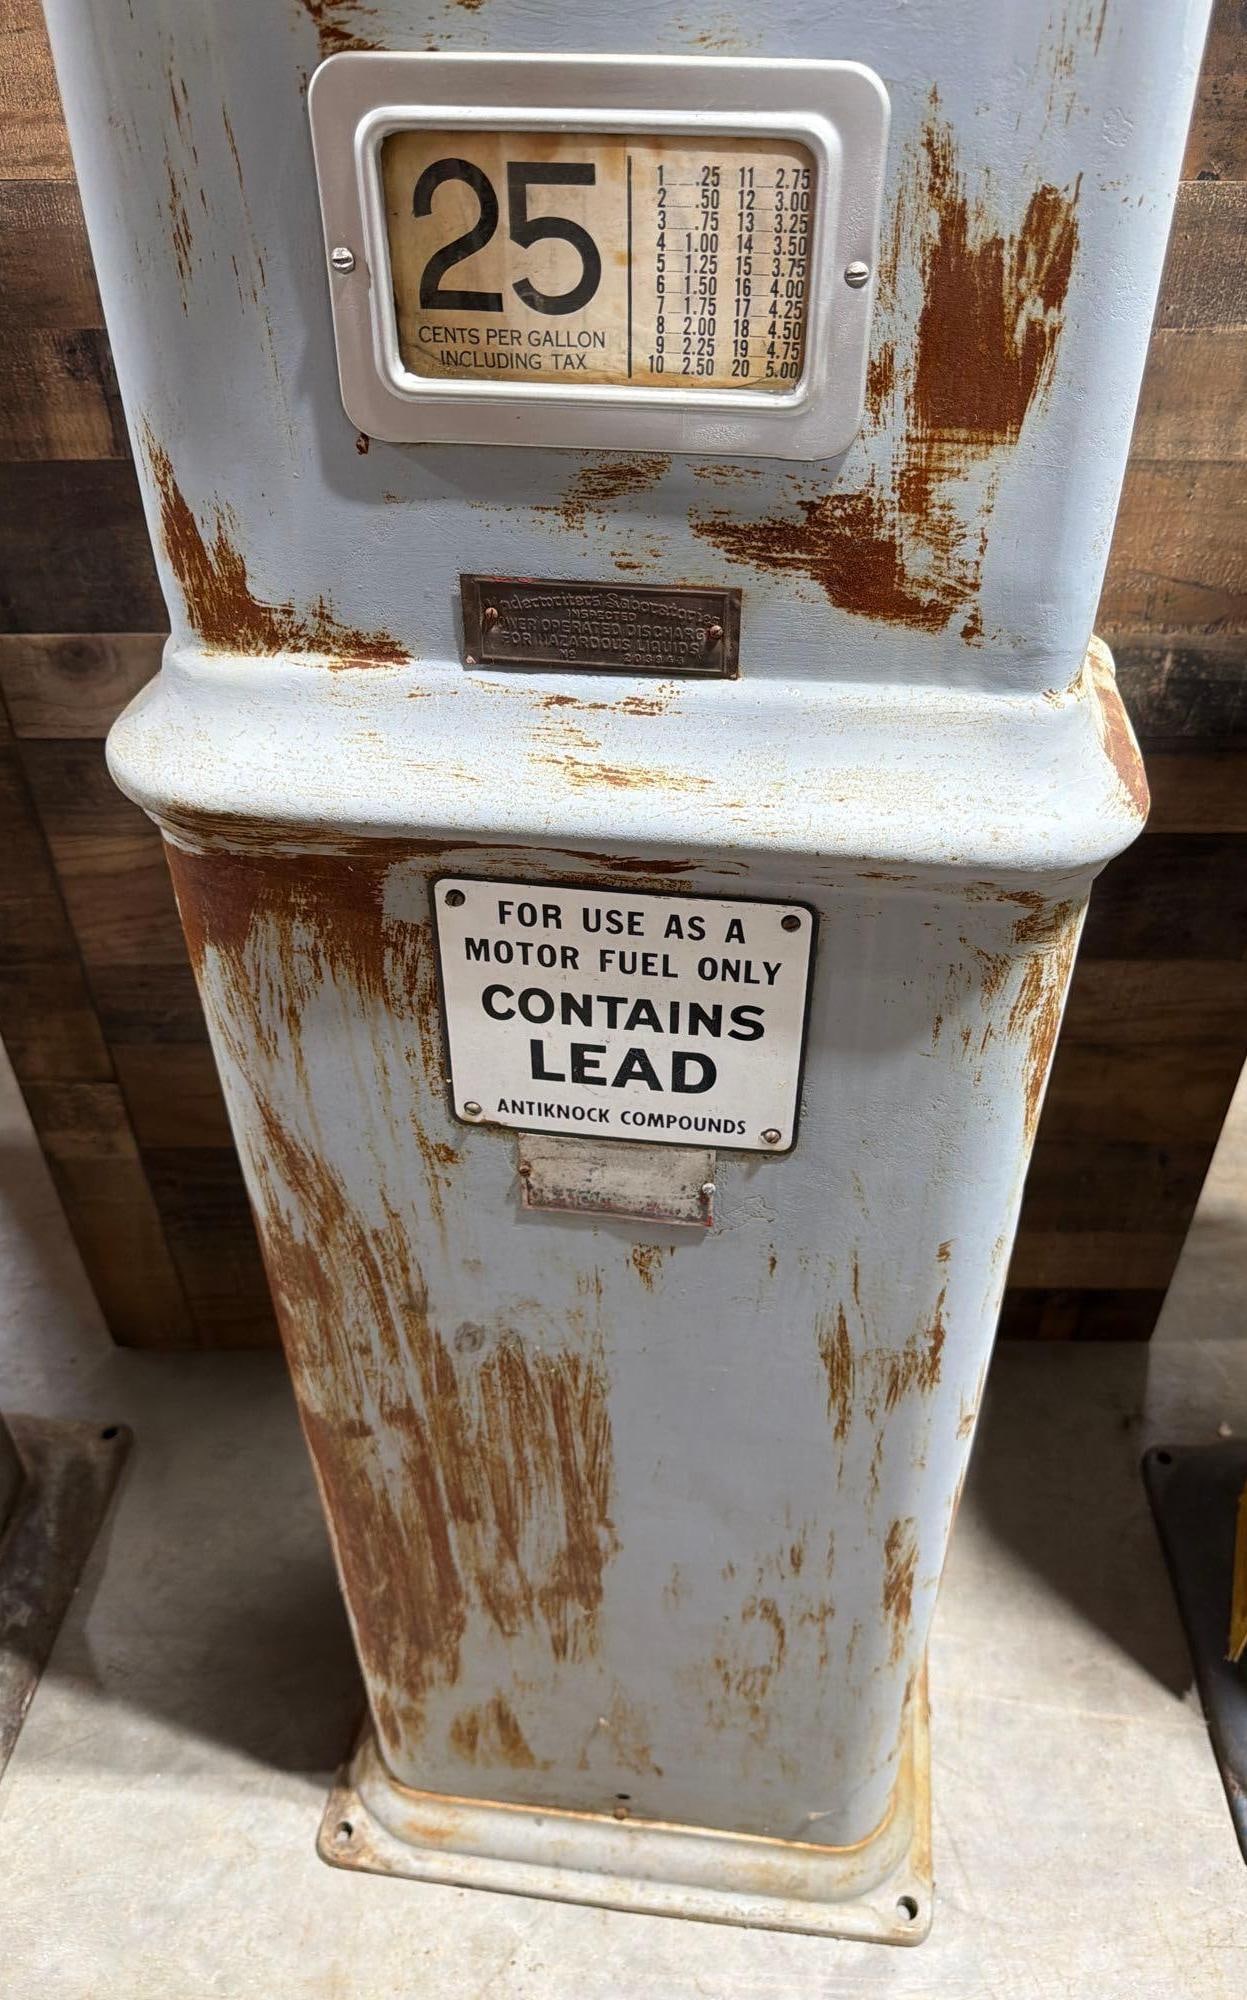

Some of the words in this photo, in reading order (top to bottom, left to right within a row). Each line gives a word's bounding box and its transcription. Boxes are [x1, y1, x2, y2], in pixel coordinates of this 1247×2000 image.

[657, 165, 664, 186] 1
[739, 167, 754, 188] 11
[776, 168, 810, 190] 2.75
[657, 188, 667, 207] 2
[738, 191, 755, 210] 12
[775, 191, 809, 212] 3.00
[657, 211, 666, 230] 3
[738, 213, 754, 232] 13
[774, 214, 808, 234] 3.25
[413, 157, 602, 316] 25
[656, 232, 666, 251] 4
[686, 233, 719, 252] 1.00
[737, 235, 753, 254] 14
[773, 236, 806, 256] 3.50
[656, 254, 665, 273] 5
[685, 255, 718, 275] 1.25
[736, 256, 752, 276] 15
[772, 258, 806, 278] 3.75
[656, 275, 665, 294] 6
[684, 277, 717, 295] 1.50
[735, 278, 751, 297] 16
[770, 279, 804, 299] 4.00
[657, 296, 665, 315] 7
[684, 297, 716, 316] 1.75
[734, 299, 750, 318] 17
[768, 300, 801, 319] 4.25
[418, 326, 480, 344] CENTS
[486, 329, 521, 346] PER
[528, 330, 606, 348] GALLON
[656, 316, 665, 335] 8
[683, 317, 715, 336] 2.00
[733, 319, 750, 337] 18
[767, 321, 801, 340] 4.50
[441, 350, 542, 370] INCLUDING
[551, 354, 588, 370] TAX
[656, 336, 664, 354] 9
[682, 338, 715, 356] 2.25
[733, 340, 748, 358] 19
[766, 341, 800, 360] 4.75
[648, 355, 664, 373] 10
[681, 357, 714, 376] 2.50
[732, 359, 749, 377] 20
[765, 361, 798, 379] 5.00
[541, 618, 620, 636] OPERATED
[500, 631, 532, 645] FOR
[637, 639, 700, 655] LIQUIDS
[498, 900, 562, 929] FOR
[582, 907, 645, 936] USE
[664, 914, 706, 941] AS
[724, 918, 746, 944] A
[464, 937, 580, 970] MOTOR
[599, 949, 679, 978] FUEL
[697, 957, 782, 985] ONLY
[481, 984, 765, 1042] CONTAINS
[529, 1039, 718, 1094] LEAD
[497, 1098, 610, 1124] ANTIKNOCK
[620, 1110, 746, 1135] COMPOUNDS
